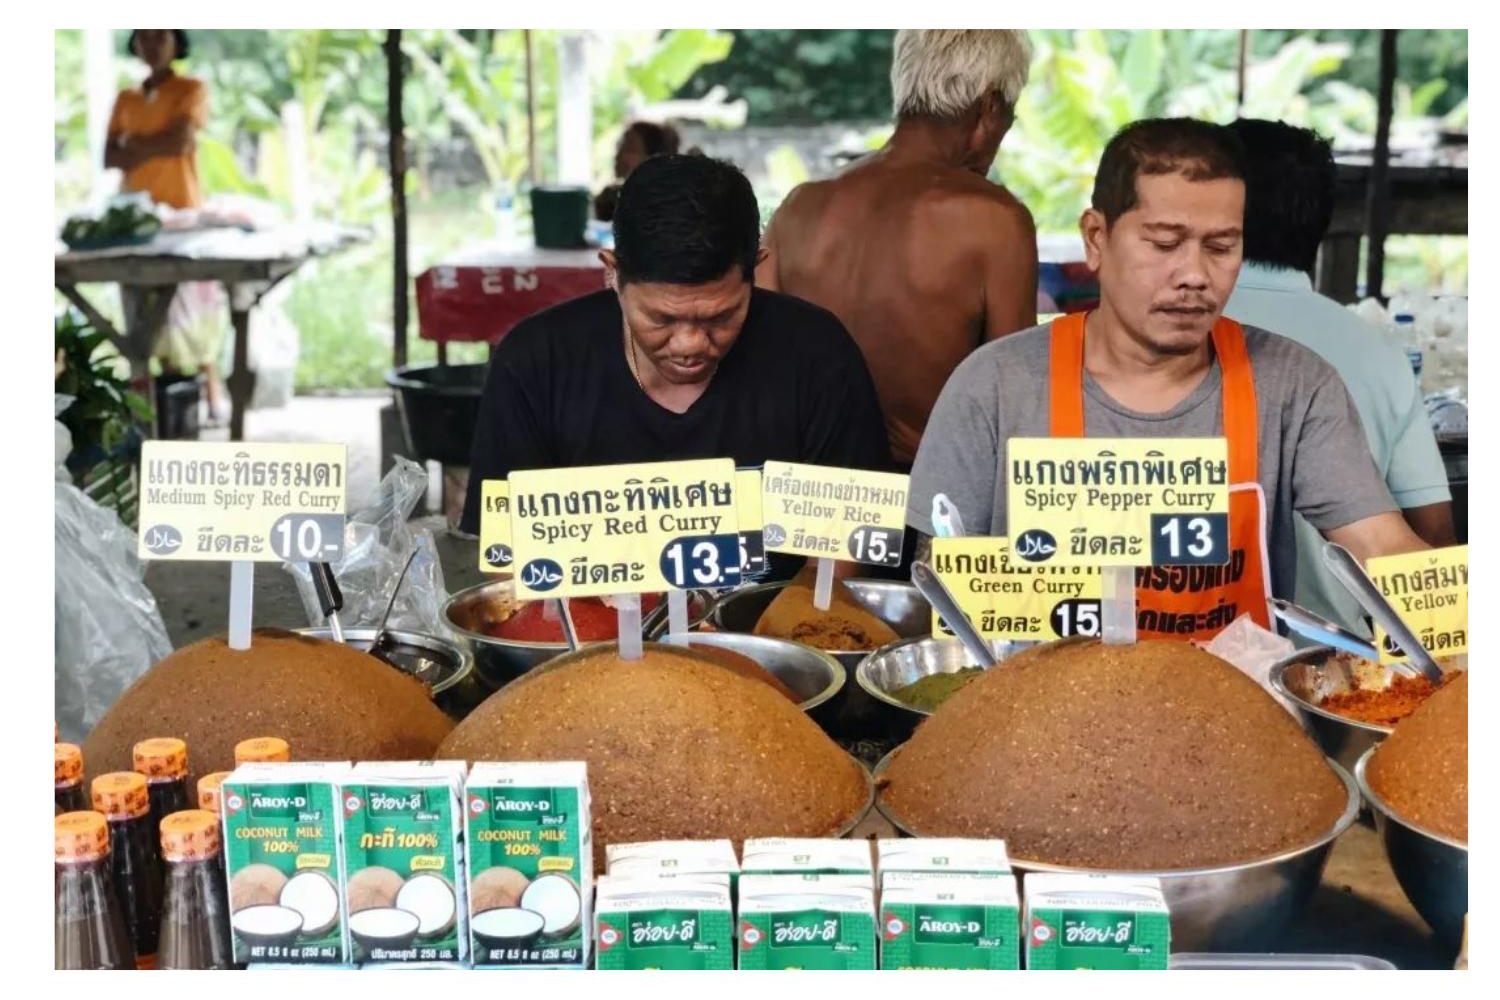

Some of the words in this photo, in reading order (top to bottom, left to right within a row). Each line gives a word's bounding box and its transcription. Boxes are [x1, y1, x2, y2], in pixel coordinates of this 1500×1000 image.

[148, 452, 342, 488] แกงกะทิธรรมดา
[1013, 450, 1227, 486] แกงพริกพิเศษ
[147, 488, 206, 505] Medium
[214, 489, 255, 510] Spicy
[262, 490, 291, 506] Red
[299, 490, 341, 512] Curry
[517, 476, 732, 518] แกงกะทิพิเศษ
[1025, 488, 1077, 511] Spicy
[1087, 489, 1153, 511] Pepper
[1162, 488, 1216, 511] Curry
[782, 498, 836, 520] Yellow
[843, 505, 881, 525] Rice
[531, 522, 593, 544] Spicy
[604, 516, 648, 536] Red
[659, 514, 722, 535] Curry
[1070, 527, 1143, 556] ขีดละ
[1160, 517, 1214, 558] 13
[197, 526, 264, 554] ขีดละ
[570, 557, 645, 586] ขีดละ
[969, 577, 1023, 593] Green
[1033, 578, 1085, 597] Curry
[1400, 593, 1459, 612] Yellow
[981, 609, 1042, 633] ขีดละ
[252, 796, 306, 809] AROY-D
[495, 800, 550, 812] AROY-D
[235, 827, 288, 839] COCONUT
[295, 827, 323, 838] MILK
[397, 833, 439, 849] 100%
[477, 830, 531, 842] COCONUT
[539, 830, 567, 841] MILK
[263, 841, 299, 854] 100%
[503, 843, 541, 857] 100%
[919, 920, 981, 933] AROY-D
[420, 948, 437, 960] 250
